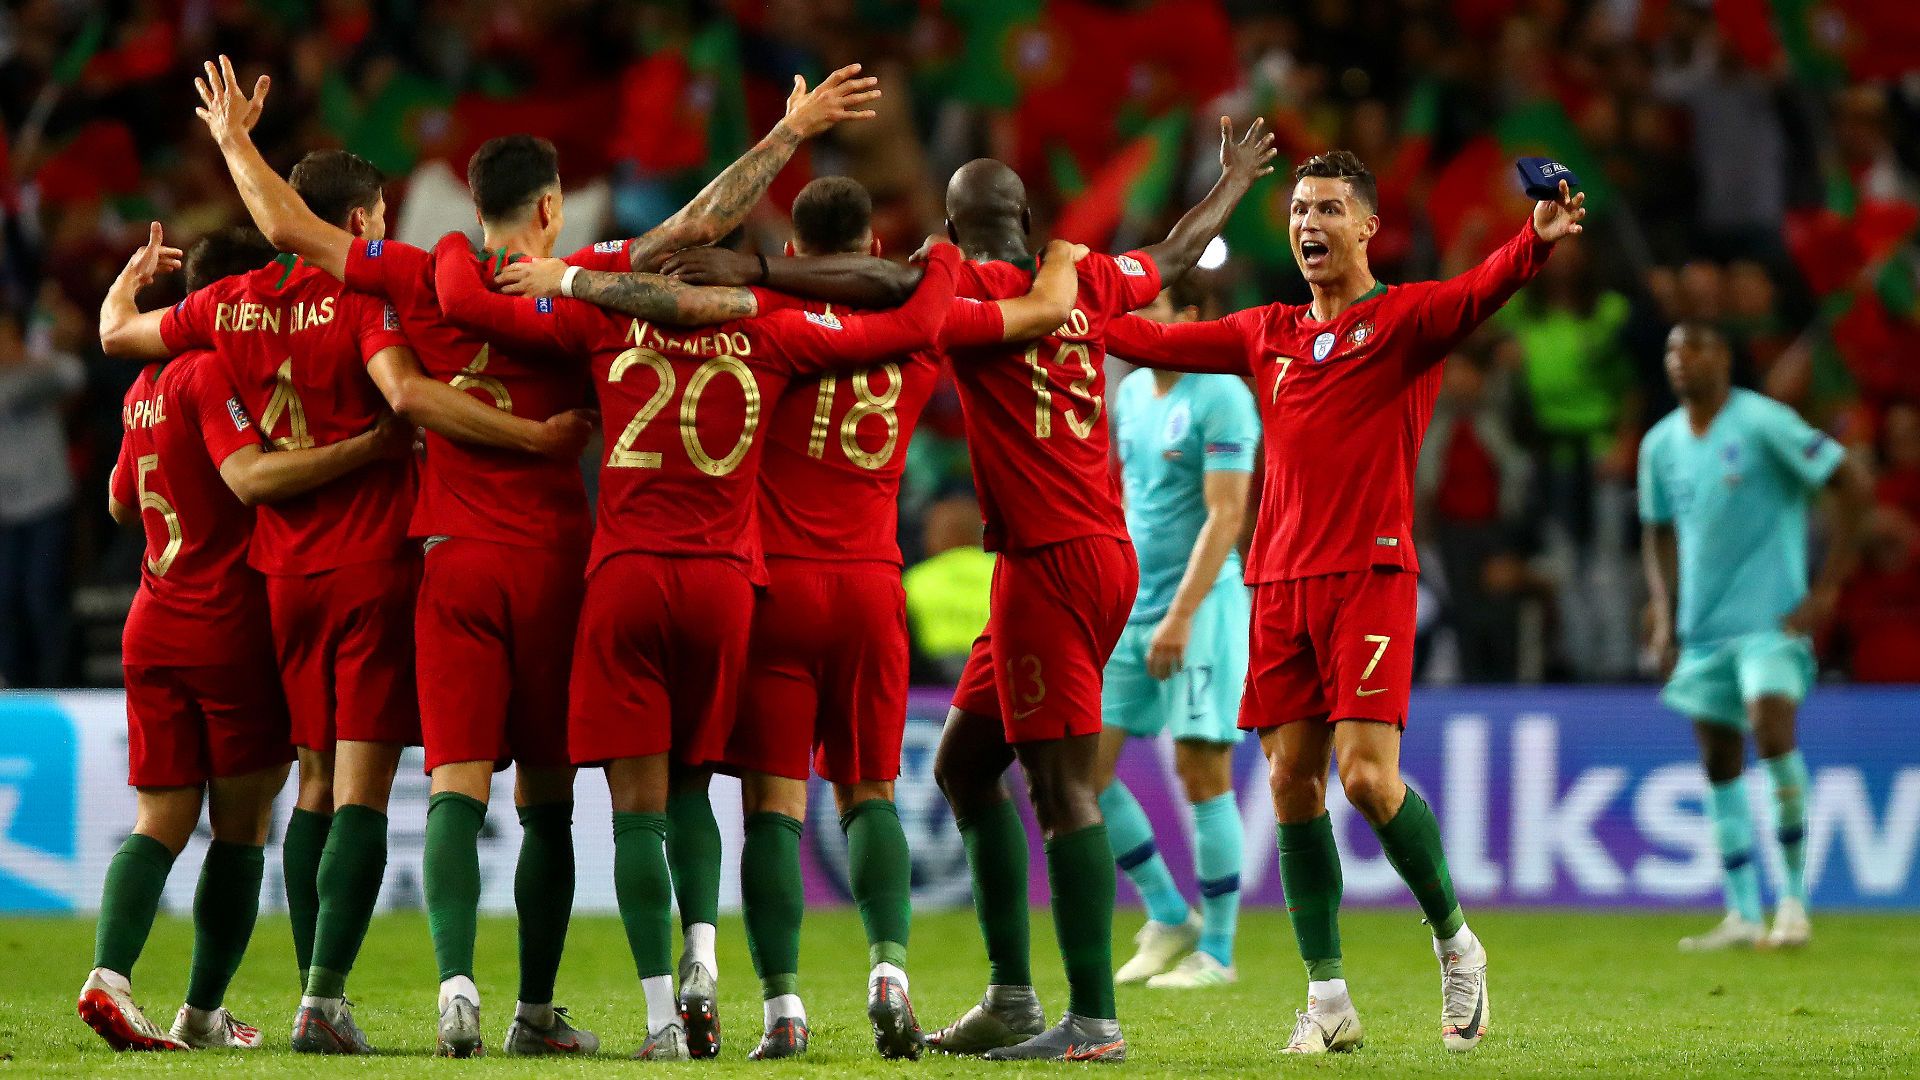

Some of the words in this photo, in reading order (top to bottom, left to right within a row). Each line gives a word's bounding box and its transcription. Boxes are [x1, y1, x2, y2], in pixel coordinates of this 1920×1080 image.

[290, 296, 334, 334] DIAS
[260, 355, 315, 450] 4
[606, 346, 761, 477] 20
[807, 361, 902, 470] 18
[1025, 341, 1101, 439] 13
[1273, 356, 1293, 405] 7
[138, 453, 183, 577] 5
[1007, 655, 1046, 704] 13
[1184, 664, 1213, 706] 17
[1360, 634, 1390, 680] 7
